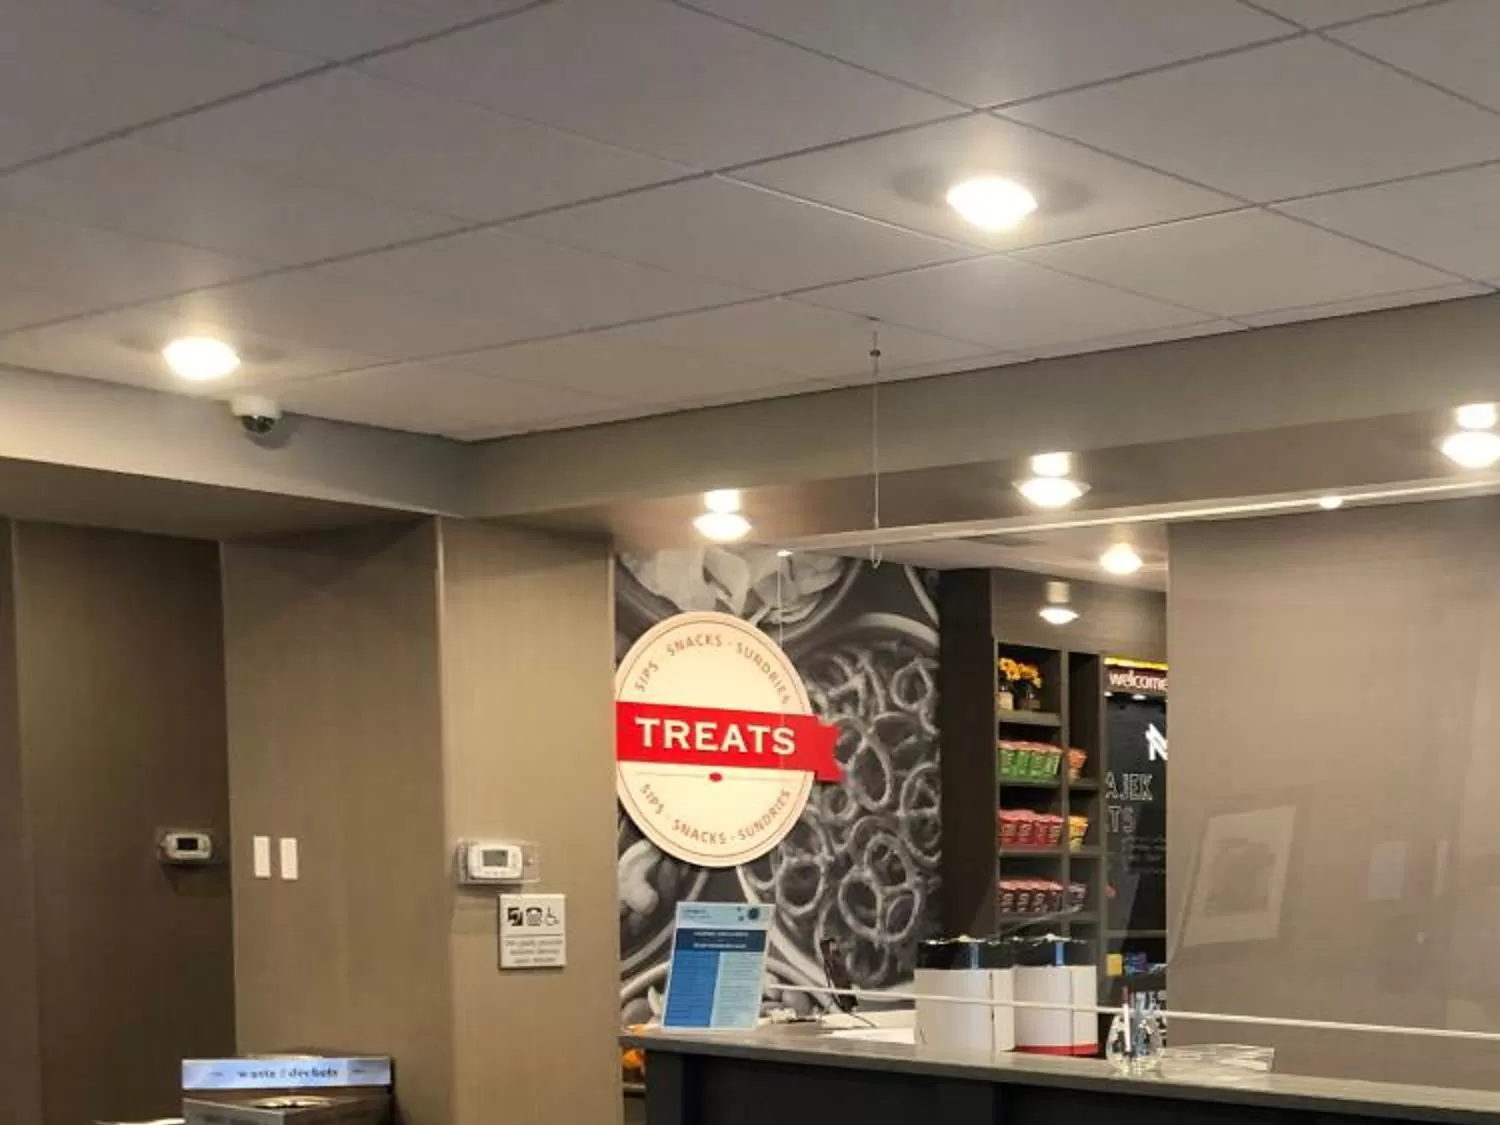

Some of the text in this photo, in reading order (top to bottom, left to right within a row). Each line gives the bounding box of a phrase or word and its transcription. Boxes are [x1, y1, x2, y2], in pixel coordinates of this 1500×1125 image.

[634, 633, 790, 705] SIPS SNACKS SUNDRIES
[634, 716, 796, 755] TREATS
[640, 784, 790, 844] SIPS SNACKS SUNDRIES
